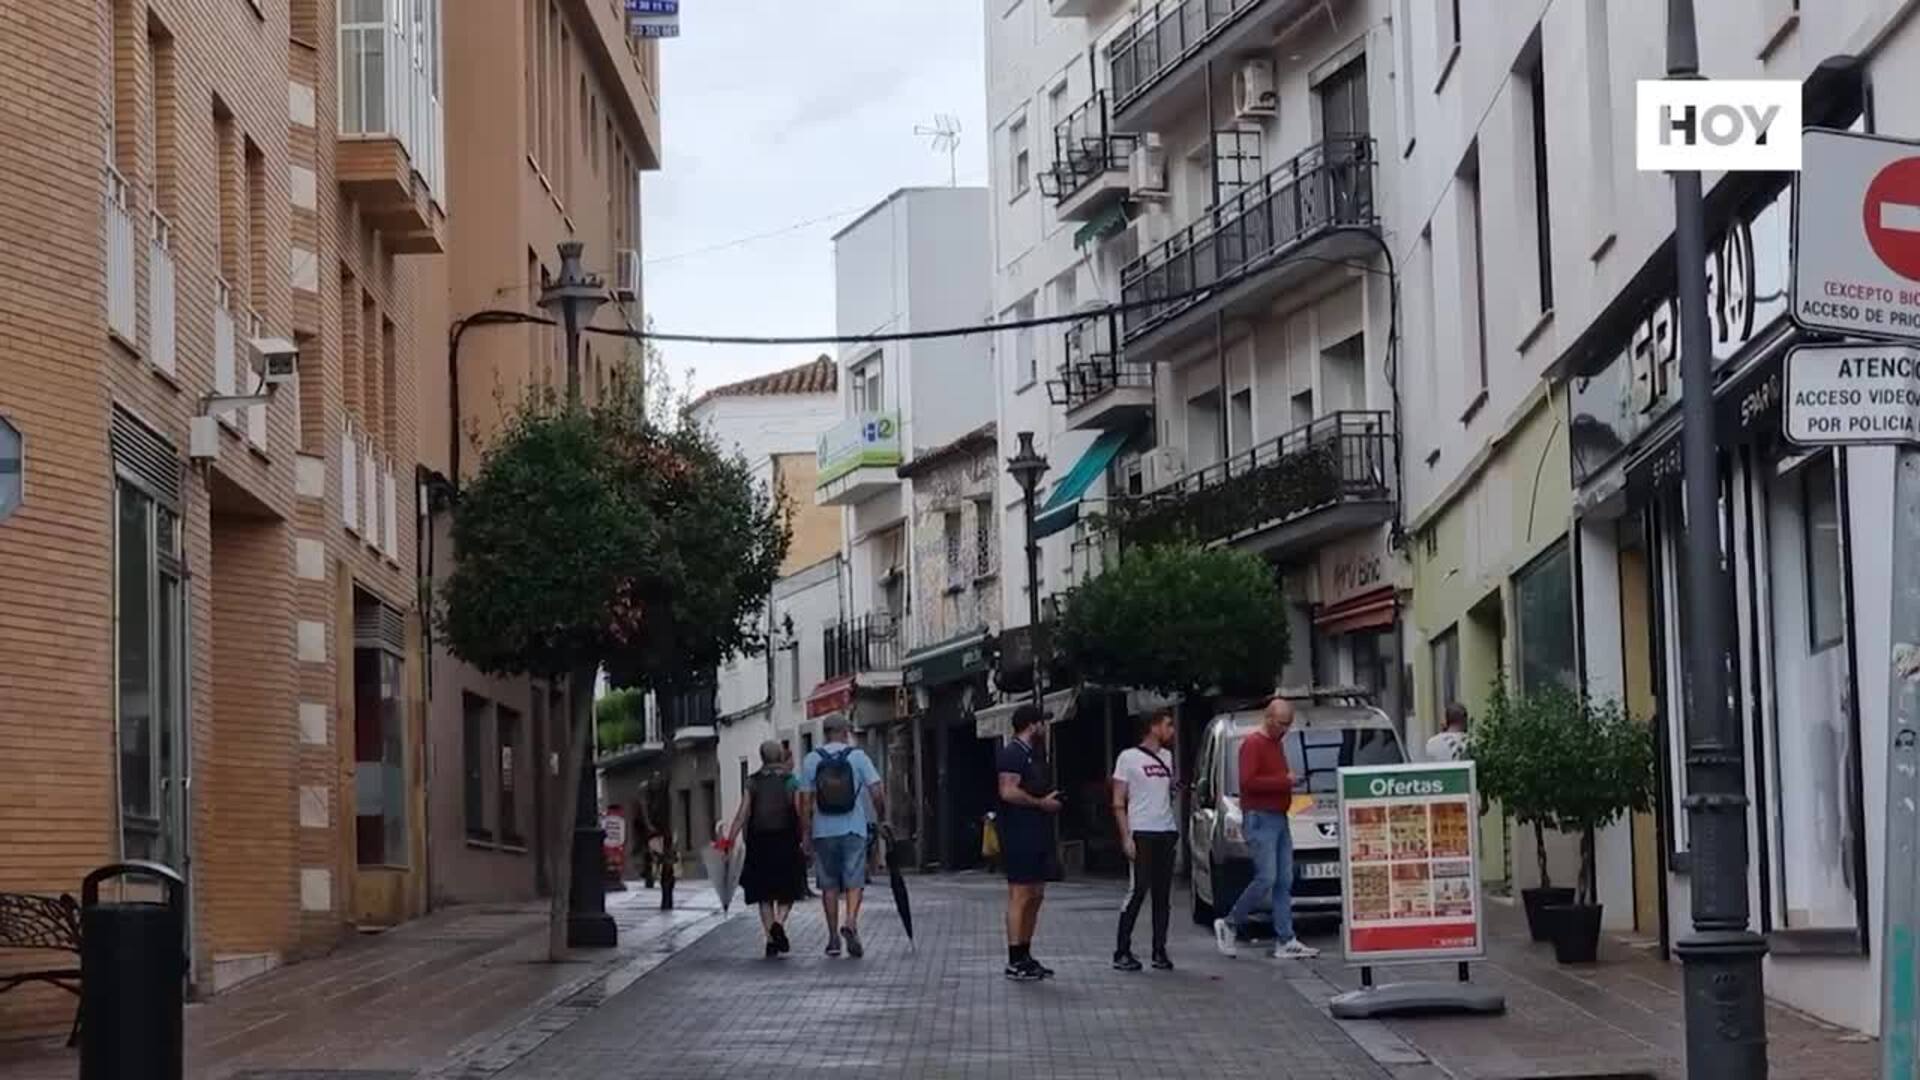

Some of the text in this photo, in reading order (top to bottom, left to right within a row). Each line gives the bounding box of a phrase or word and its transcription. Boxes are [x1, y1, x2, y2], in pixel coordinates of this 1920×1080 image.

[1824, 280, 1893, 303] (EXCEPTO
[1802, 300, 1860, 320] ACCESO
[1865, 308, 1884, 323] DE
[1795, 389, 1862, 406] ACCESO
[1808, 415, 1914, 432] POR POLICIA
[1370, 778, 1444, 796] Ofertas
